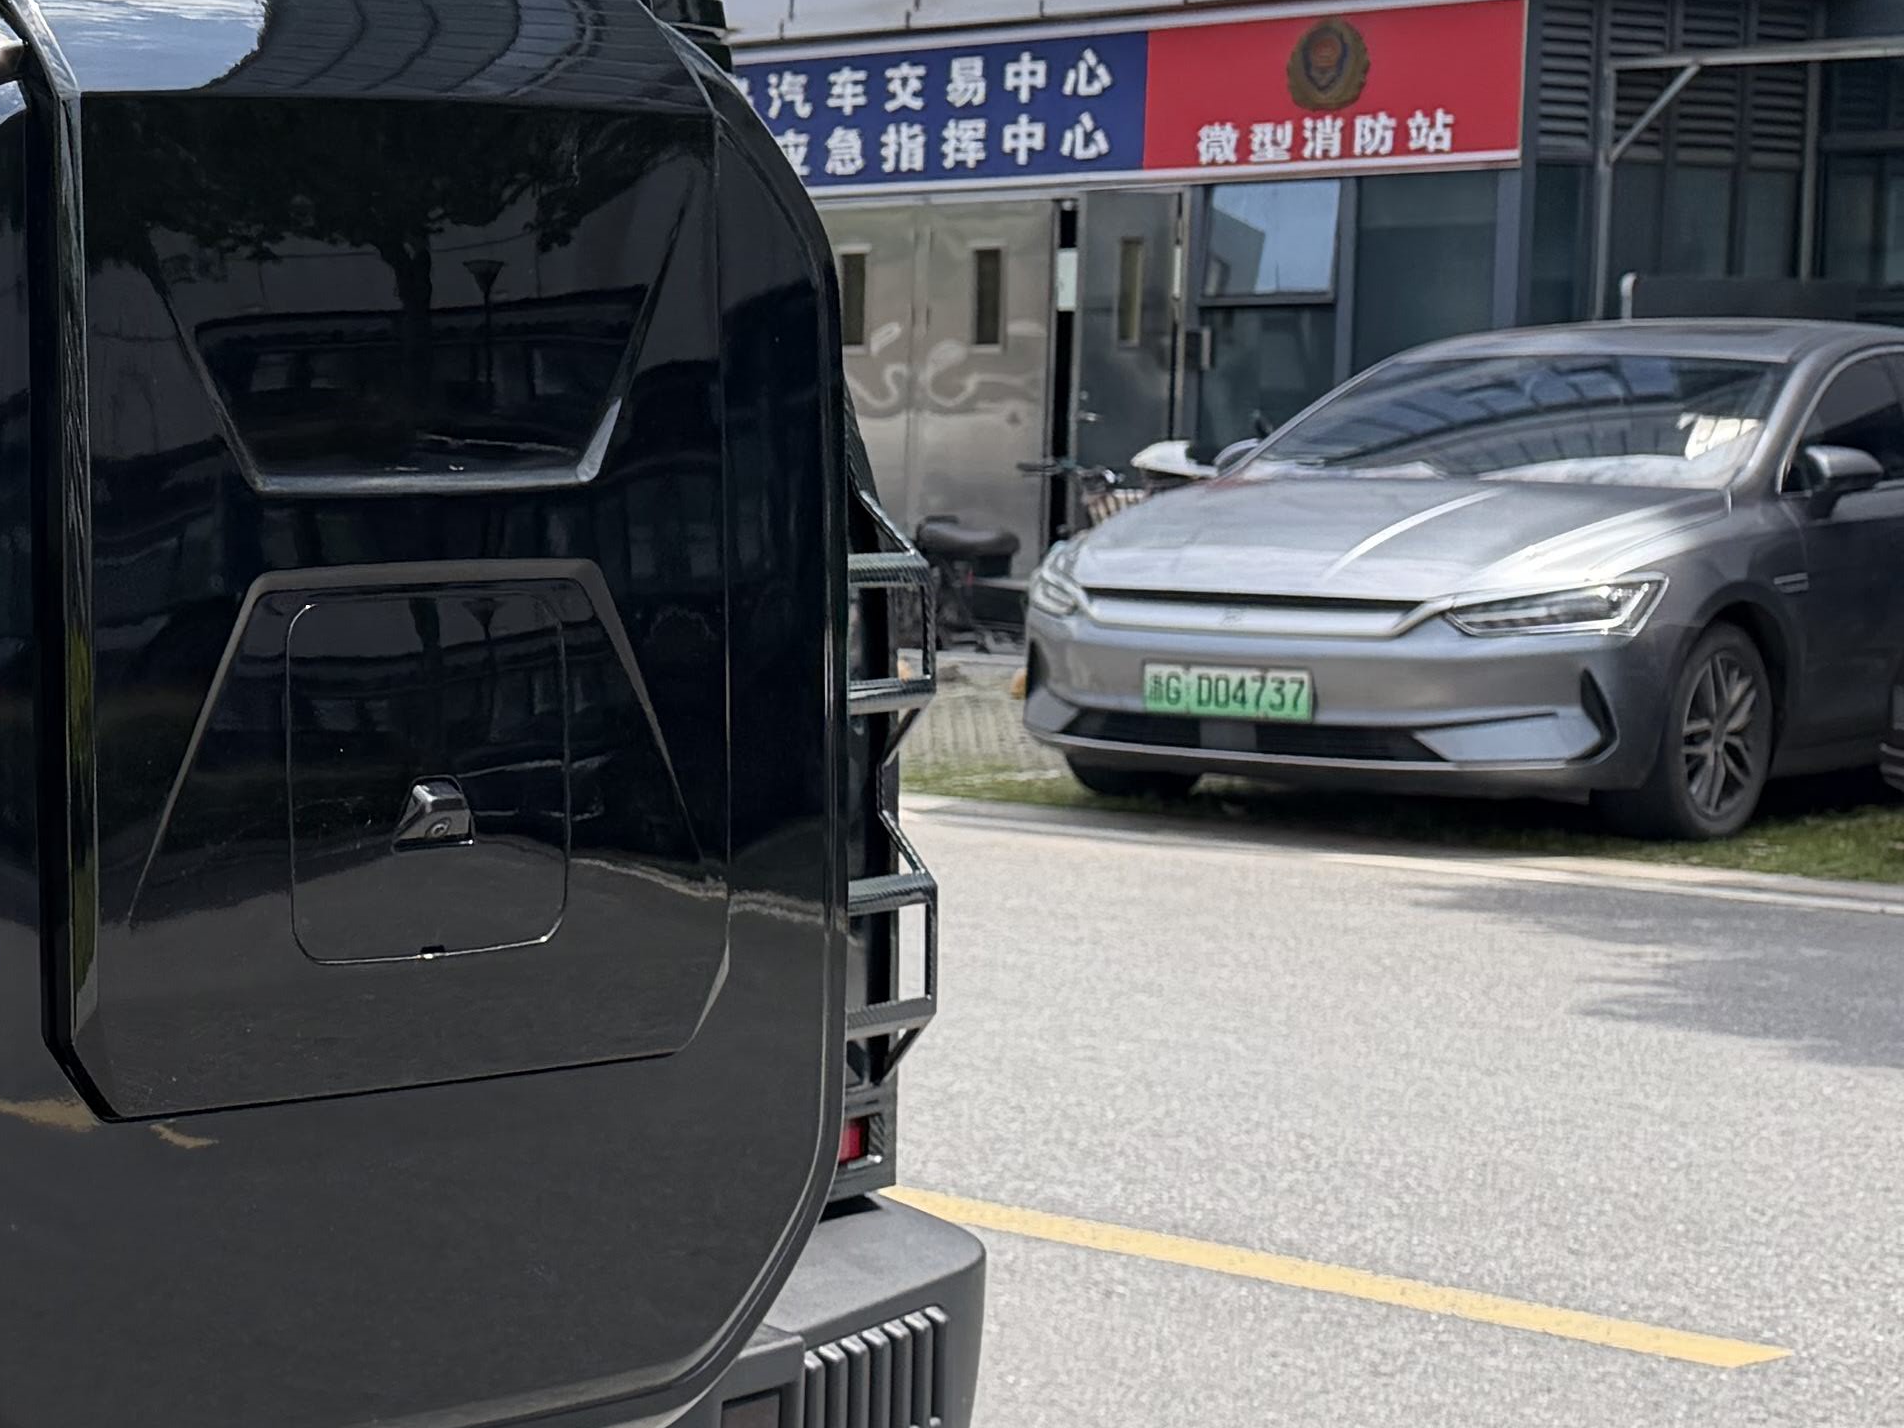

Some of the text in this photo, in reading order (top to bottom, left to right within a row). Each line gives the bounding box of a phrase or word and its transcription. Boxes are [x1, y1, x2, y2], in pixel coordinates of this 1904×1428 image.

[1197, 108, 1456, 165] 微型消防站
